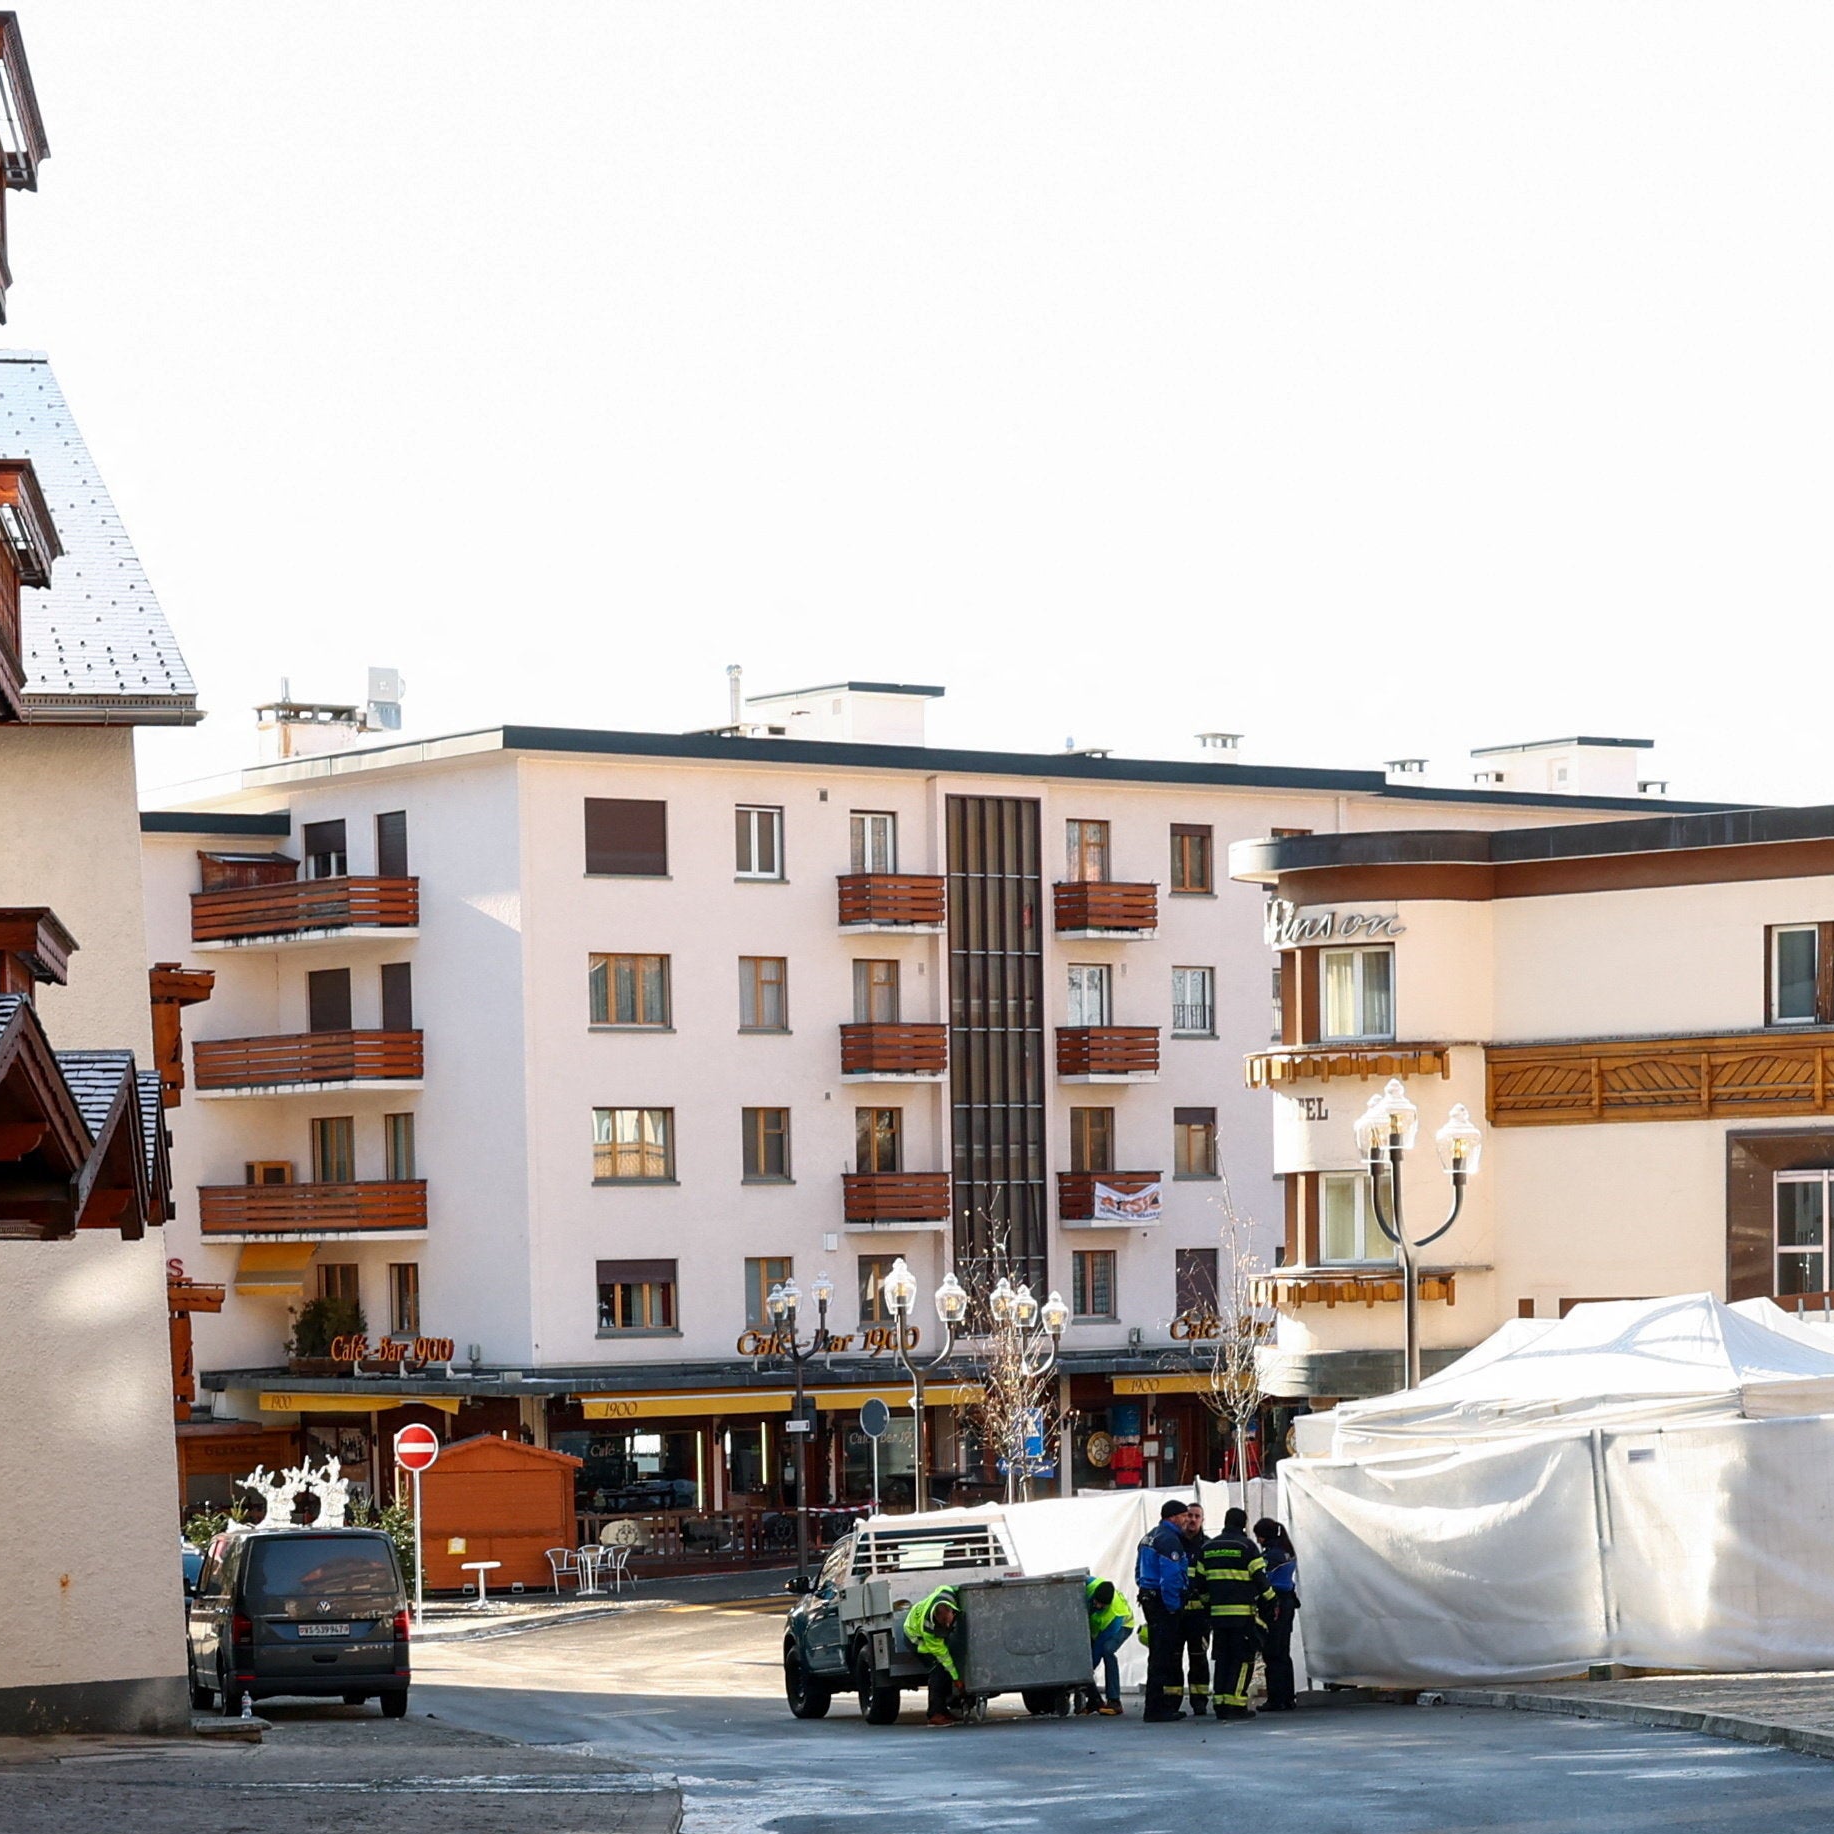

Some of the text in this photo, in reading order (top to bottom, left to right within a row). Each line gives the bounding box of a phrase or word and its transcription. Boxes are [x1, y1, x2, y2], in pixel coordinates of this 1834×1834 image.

[330, 1334, 368, 1362] Café
[379, 1336, 407, 1362] Bar
[410, 1337, 455, 1368] 1900
[1130, 1378, 1161, 1393] 1900
[270, 1395, 292, 1410] 1900
[604, 1401, 638, 1417] 1900
